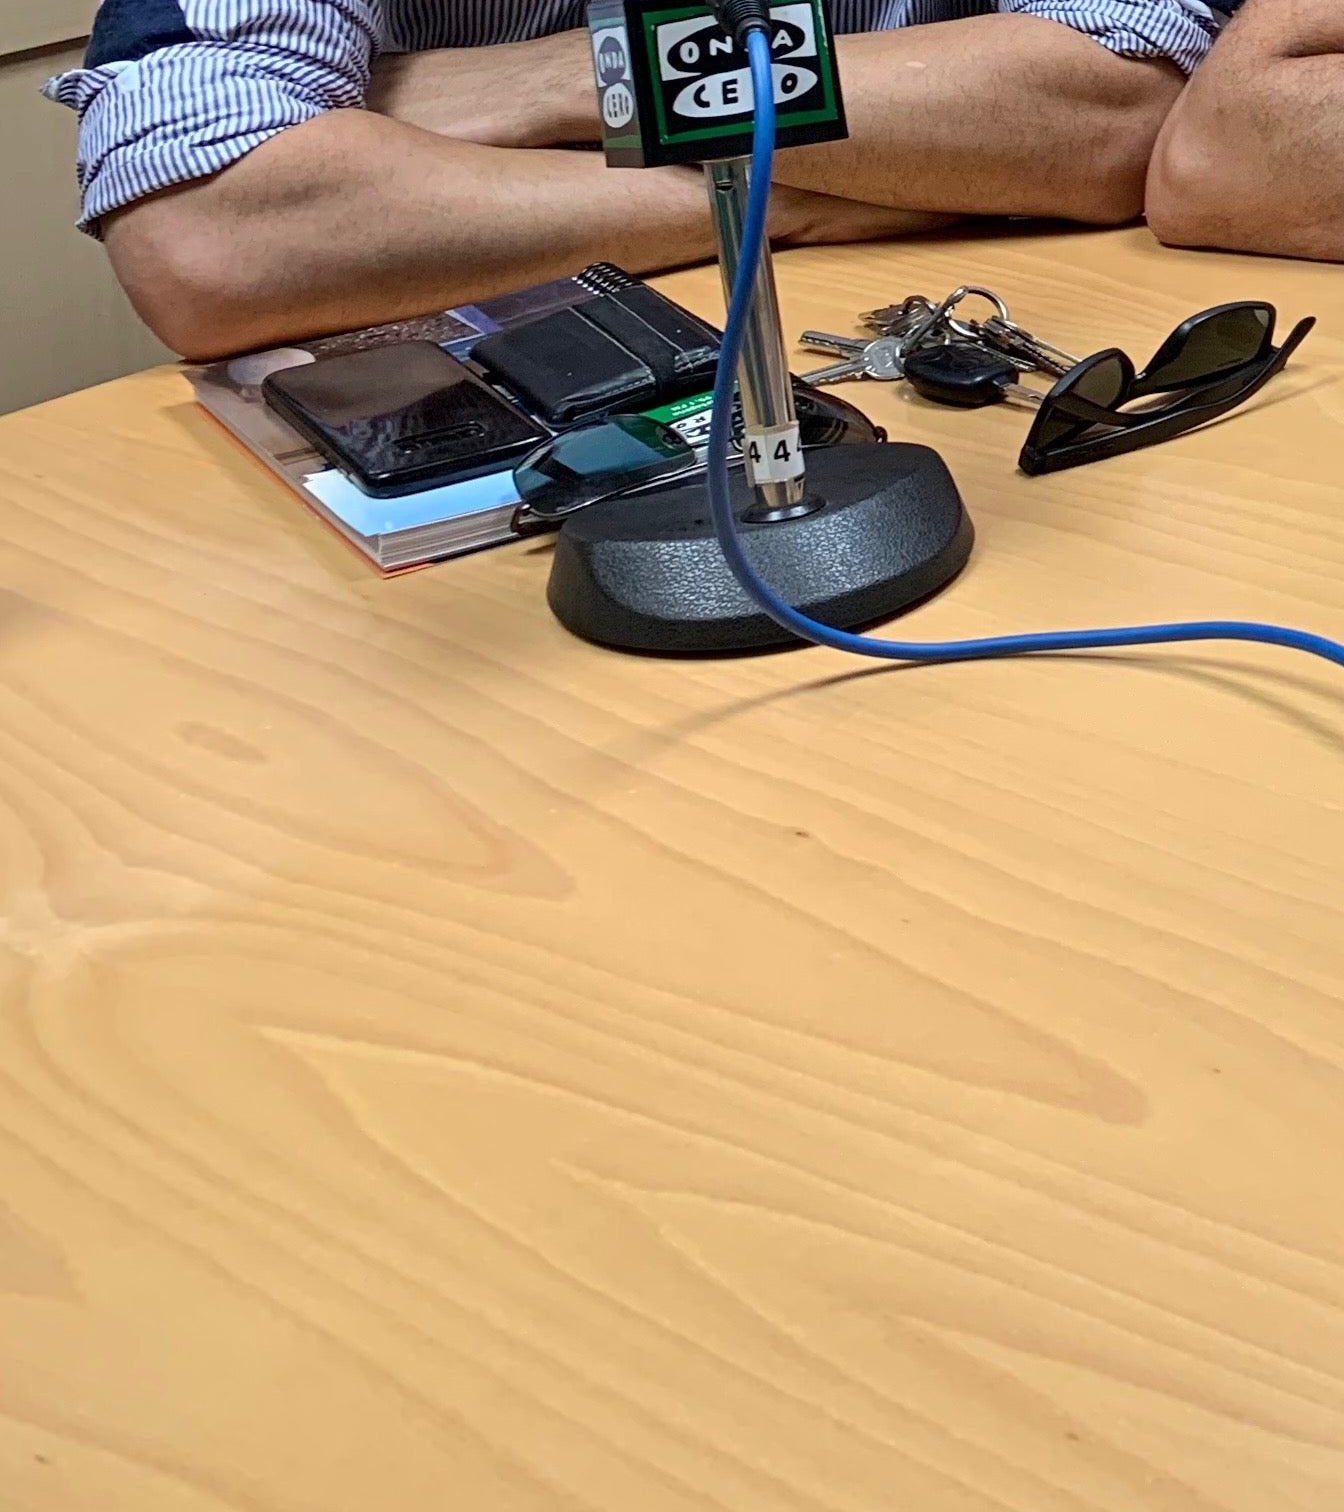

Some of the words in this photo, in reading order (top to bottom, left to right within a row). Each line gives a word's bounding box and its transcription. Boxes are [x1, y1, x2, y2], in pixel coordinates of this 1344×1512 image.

[679, 29, 794, 64] ONA
[693, 72, 798, 109] CEO
[748, 440, 762, 464] 4
[774, 440, 791, 463] 4
